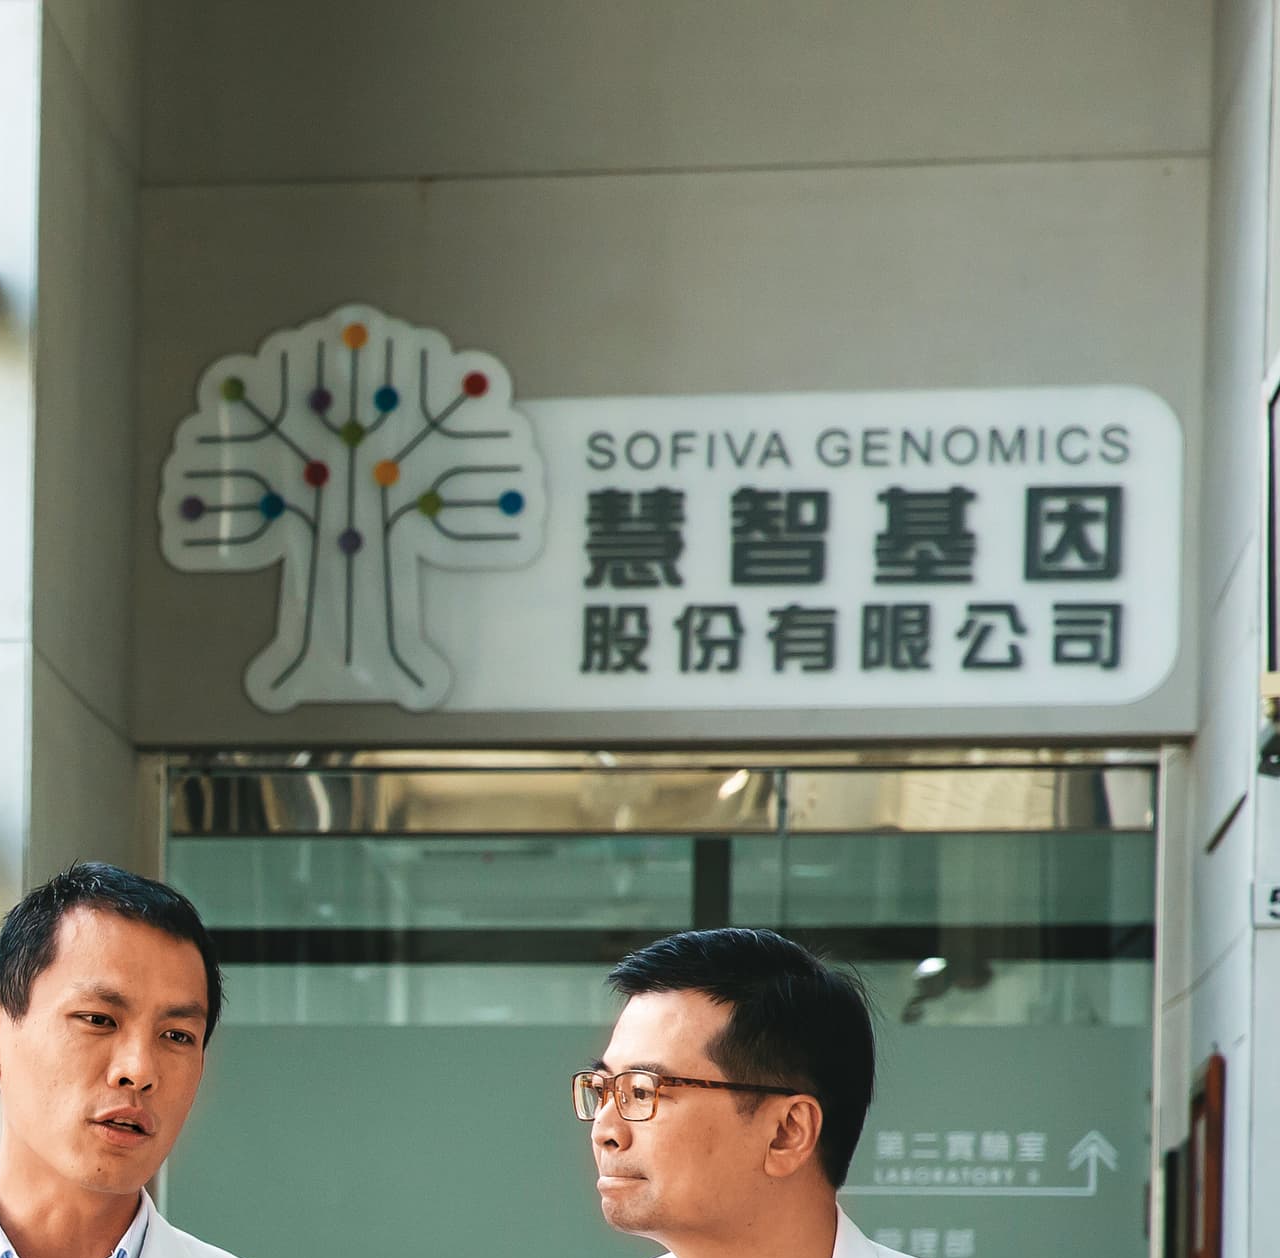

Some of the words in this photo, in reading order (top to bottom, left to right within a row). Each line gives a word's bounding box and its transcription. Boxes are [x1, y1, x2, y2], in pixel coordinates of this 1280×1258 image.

[586, 430, 792, 471] SOFIVA
[816, 424, 1130, 468] GENOMICS
[584, 485, 1124, 589] 慧智基因
[580, 603, 1124, 674] 股份有限公司
[873, 1166, 1015, 1186] LABORATORY
